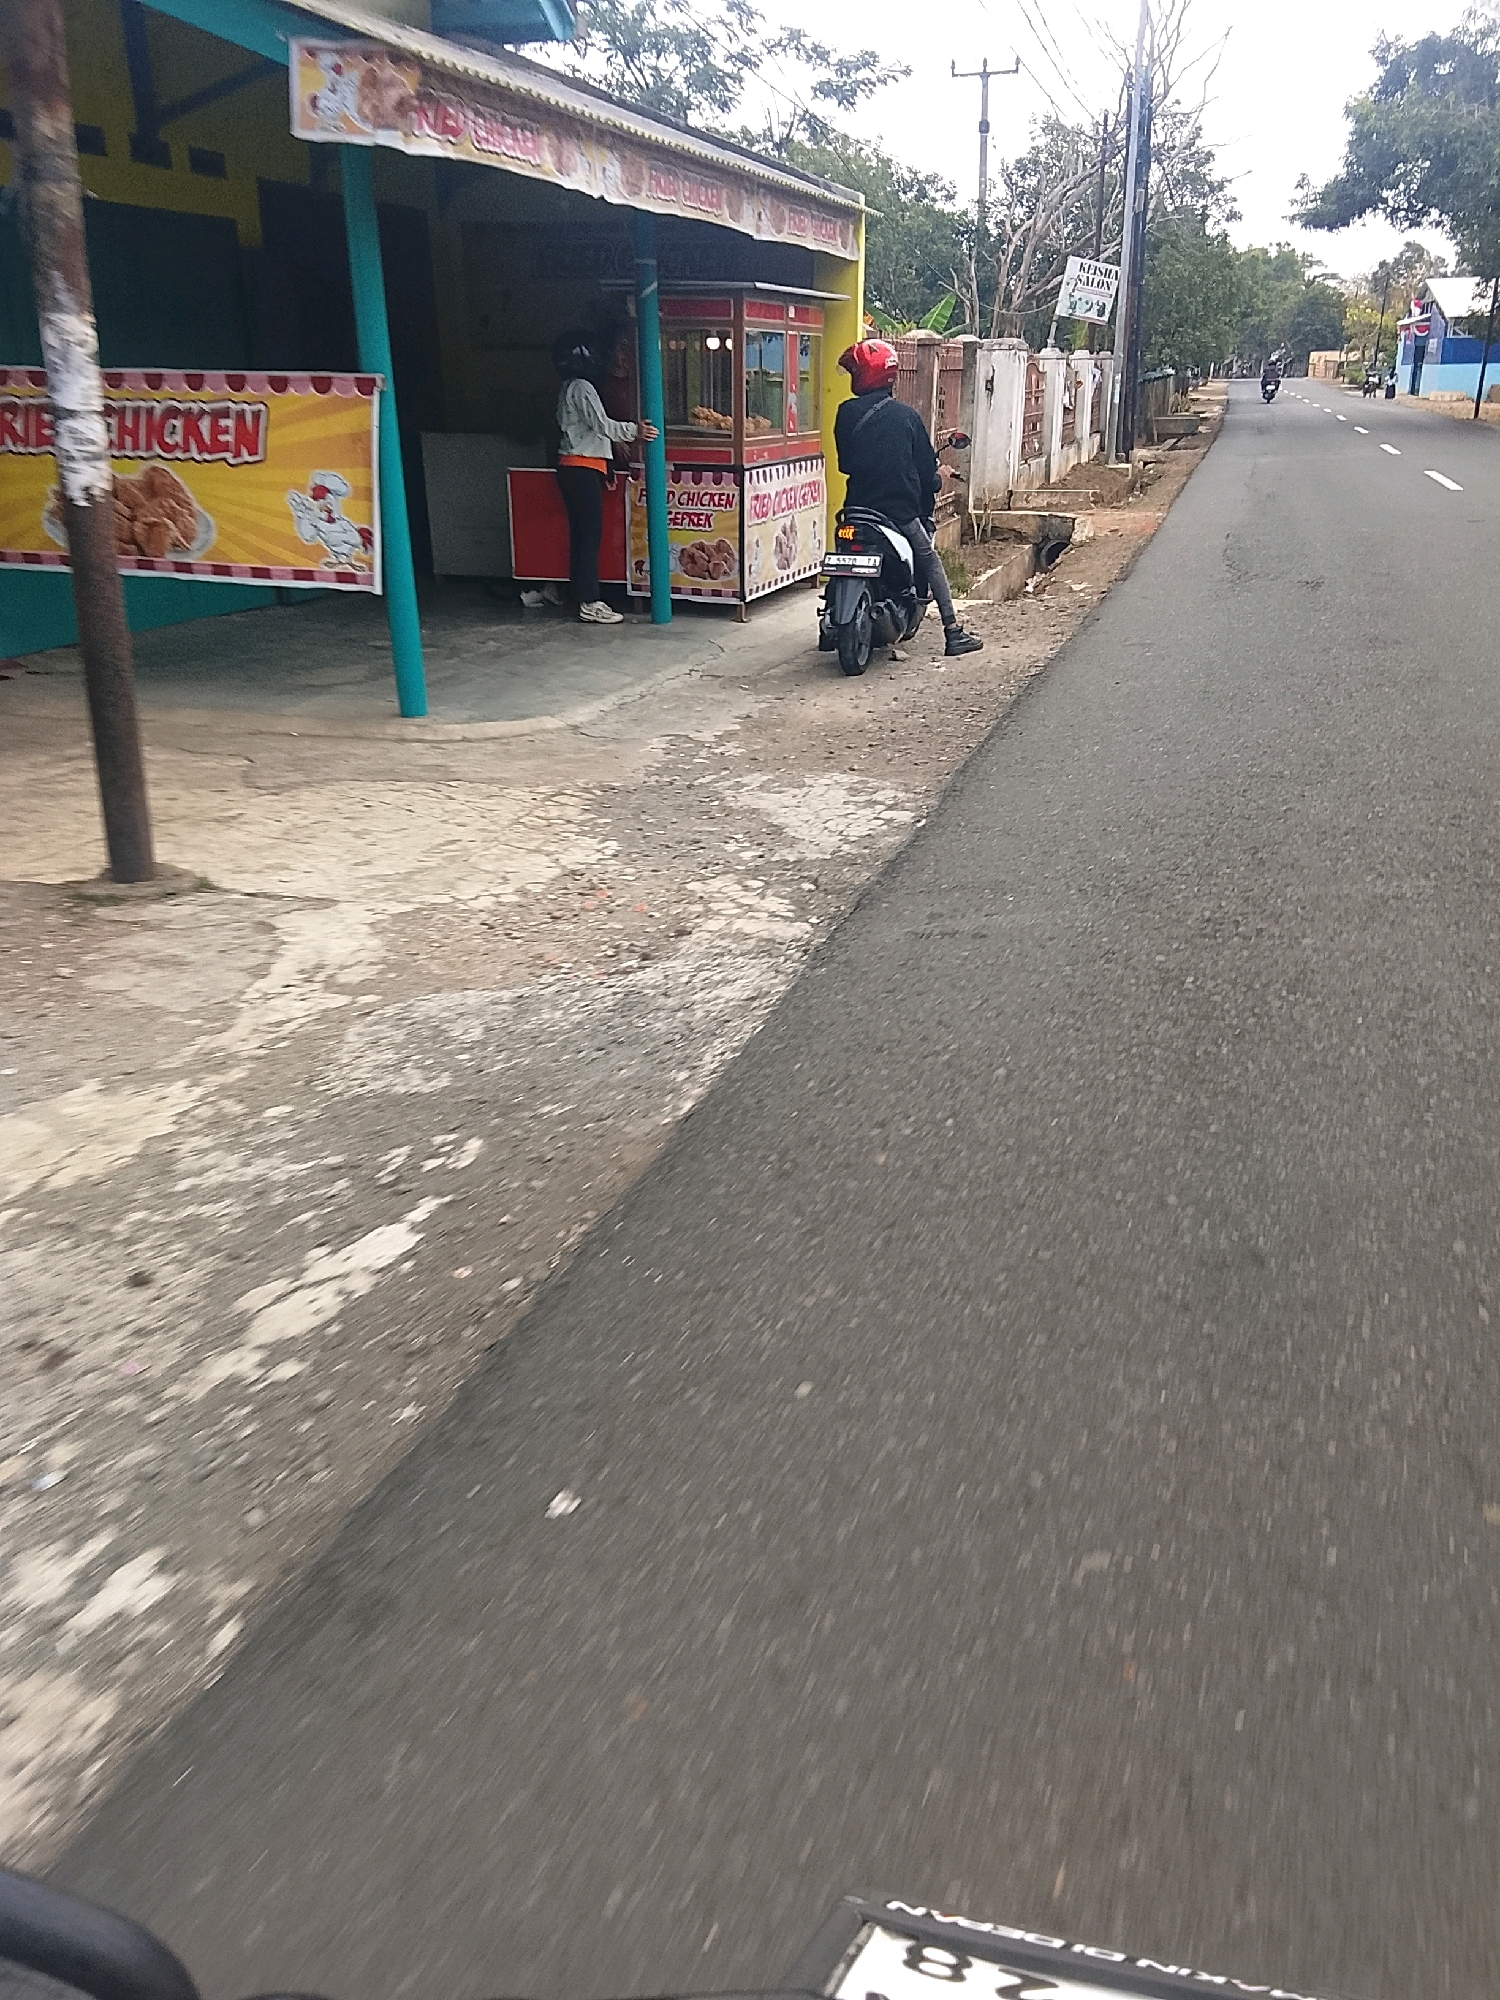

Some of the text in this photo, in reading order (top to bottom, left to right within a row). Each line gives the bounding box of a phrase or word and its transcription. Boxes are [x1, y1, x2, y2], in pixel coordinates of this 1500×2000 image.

[1079, 262, 1118, 281] KEISHA
[1077, 275, 1112, 291] SALON
[0, 404, 54, 447] RIE
[677, 491, 735, 509] CHICKEN
